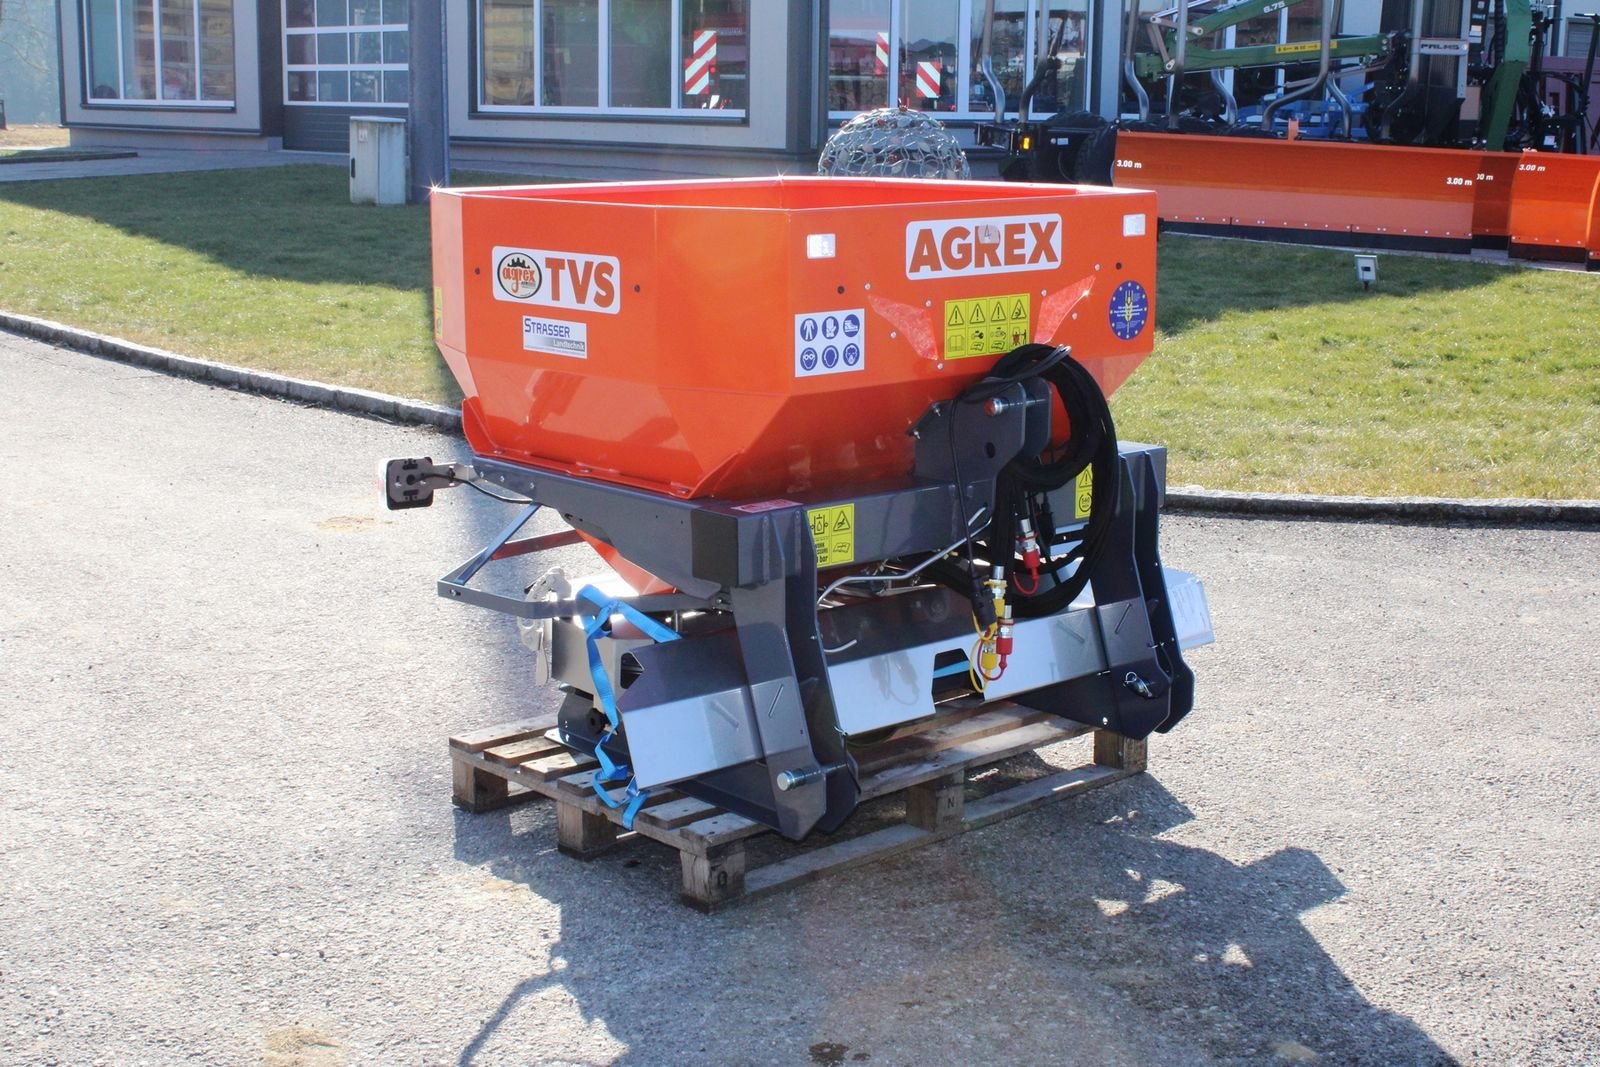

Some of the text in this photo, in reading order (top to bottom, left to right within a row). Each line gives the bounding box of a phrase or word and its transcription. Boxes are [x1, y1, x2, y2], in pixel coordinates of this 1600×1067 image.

[1117, 159, 1133, 168] 3.00
[1446, 177, 1463, 185] 3.00
[909, 221, 1059, 273] AGREX
[502, 267, 535, 293] agrex
[545, 257, 615, 308] TVS
